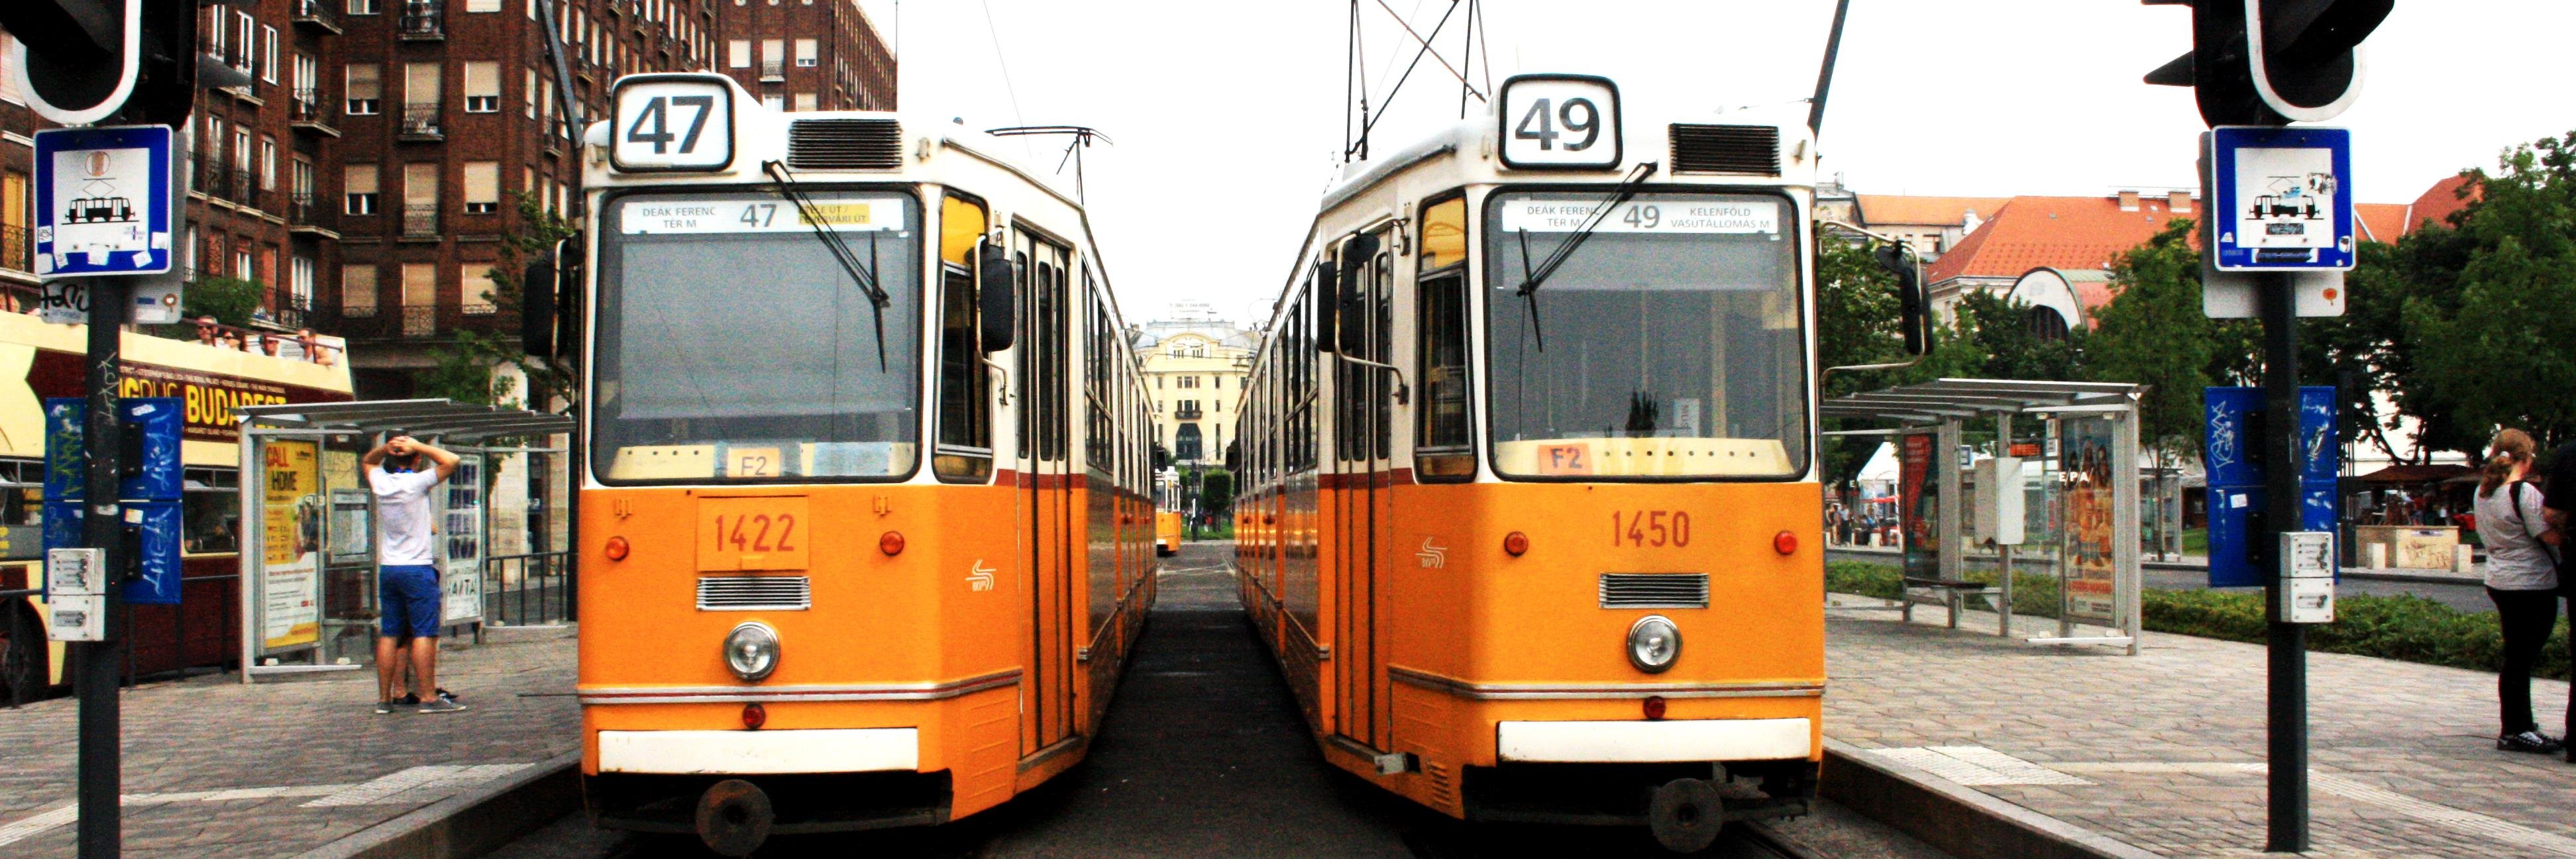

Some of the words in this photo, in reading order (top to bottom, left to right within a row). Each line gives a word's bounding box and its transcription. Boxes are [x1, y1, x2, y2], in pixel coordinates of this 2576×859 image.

[627, 95, 714, 155] 47
[1515, 97, 1600, 152] 49
[643, 207, 671, 217] DEÁK
[676, 207, 716, 217] FERENC
[739, 203, 777, 228] 47
[1527, 205, 1556, 215] DEÁK
[1560, 206, 1601, 215] FERENC
[1623, 205, 1660, 228] 49
[1690, 206, 1751, 217] KELENFÖLD
[663, 218, 684, 228] TÉR
[686, 219, 697, 228] M
[1547, 218, 1566, 227] TÉR
[1760, 220, 1770, 228] M
[266, 446, 289, 468] CALL
[741, 456, 767, 476] F2
[1550, 447, 1582, 469] F2
[272, 471, 297, 491] HOME
[715, 513, 794, 553] 1422
[1613, 510, 1690, 548] 1450
